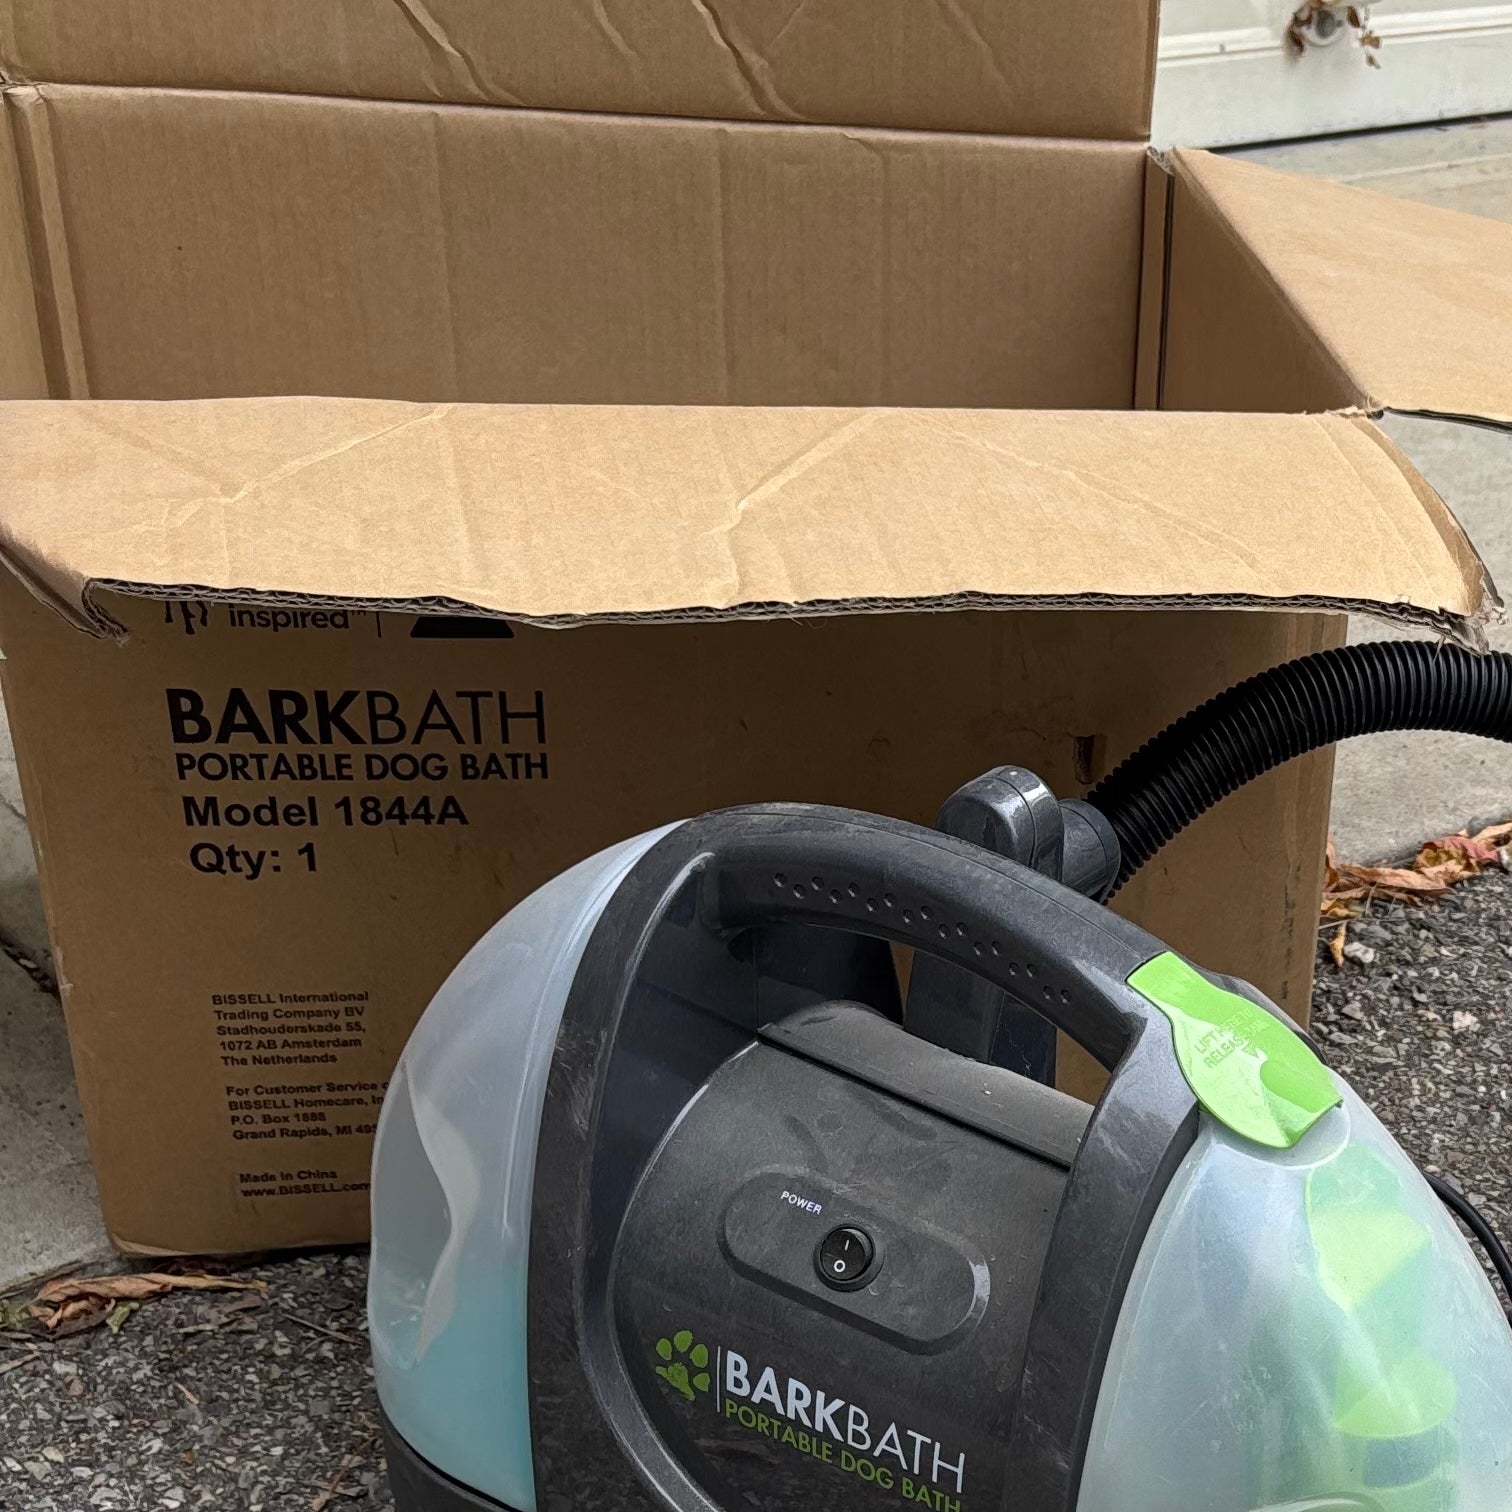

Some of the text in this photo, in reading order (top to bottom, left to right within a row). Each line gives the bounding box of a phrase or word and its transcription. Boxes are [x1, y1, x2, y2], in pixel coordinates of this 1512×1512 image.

[166, 688, 546, 745] BARKBATH
[176, 753, 548, 781] PORTABLE DOG BATH
[182, 796, 469, 827] Model 1844A
[190, 842, 316, 880] Qty: 1
[212, 991, 368, 1005] BISSELL International
[214, 1006, 365, 1021] Trading Company BV
[345, 1021, 366, 1034] 55,
[220, 1037, 362, 1051] 1072 AB Amsterdam
[221, 1053, 338, 1066] The Netherlands
[226, 1086, 250, 1097] For
[253, 1082, 323, 1096] Customer
[326, 1080, 378, 1093] Service
[228, 1100, 291, 1111] BISSELL
[231, 1115, 258, 1126] P.O.
[262, 1113, 290, 1124] Box
[232, 1129, 276, 1141] Grand
[279, 1126, 332, 1140] Rapids,
[336, 1125, 353, 1136] MI
[239, 1173, 276, 1184] Made
[297, 1169, 338, 1181] China
[241, 1182, 371, 1197] www.BISSELL.com
[780, 1190, 823, 1215] POWER
[725, 1350, 966, 1494] BARKBATH
[724, 1398, 833, 1465] PORTABLE
[840, 1447, 895, 1490] DOG
